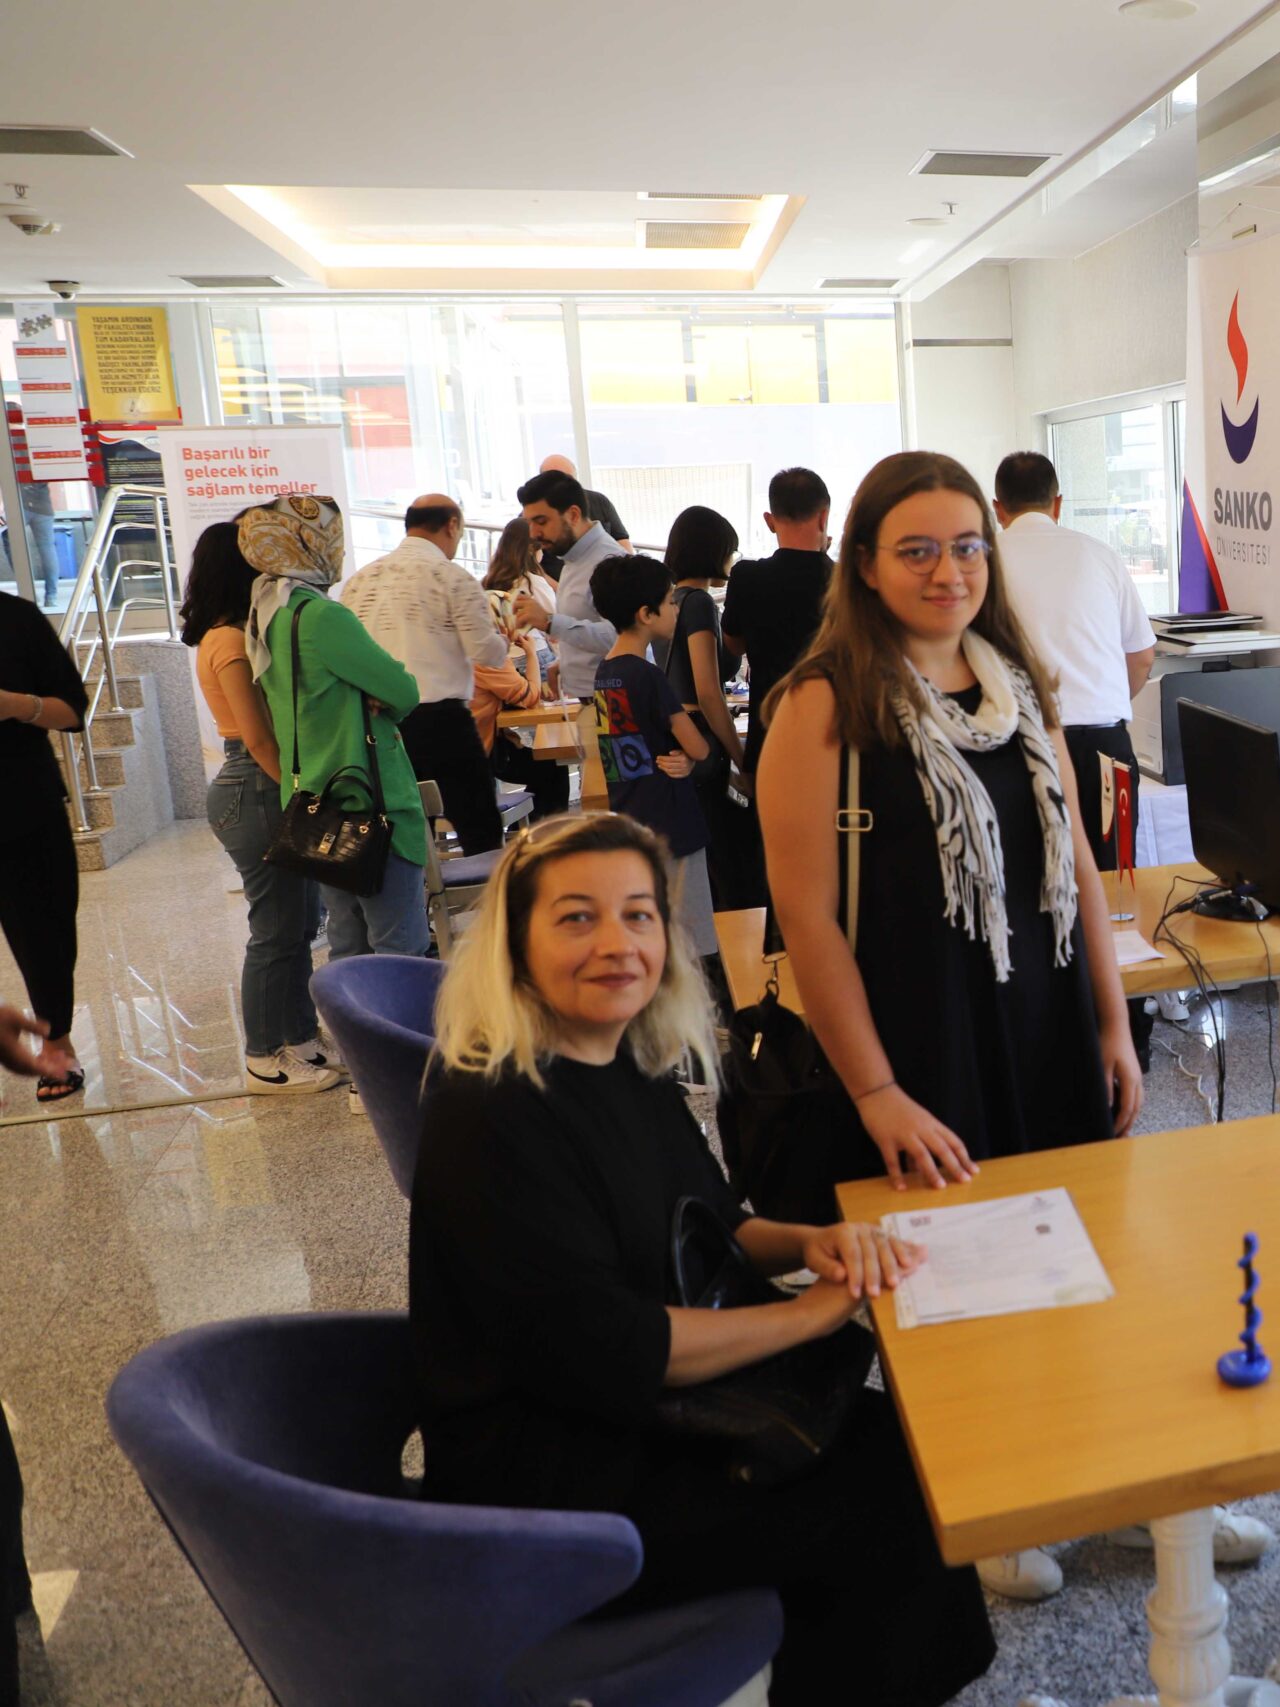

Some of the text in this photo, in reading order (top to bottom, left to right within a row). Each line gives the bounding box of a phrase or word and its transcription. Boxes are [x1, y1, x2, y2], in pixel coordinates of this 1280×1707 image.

[182, 446, 271, 462] Başarılı bir
[184, 464, 279, 481] gelecek için
[186, 481, 318, 499] sağlam temeller
[1213, 487, 1272, 531] SANKO
